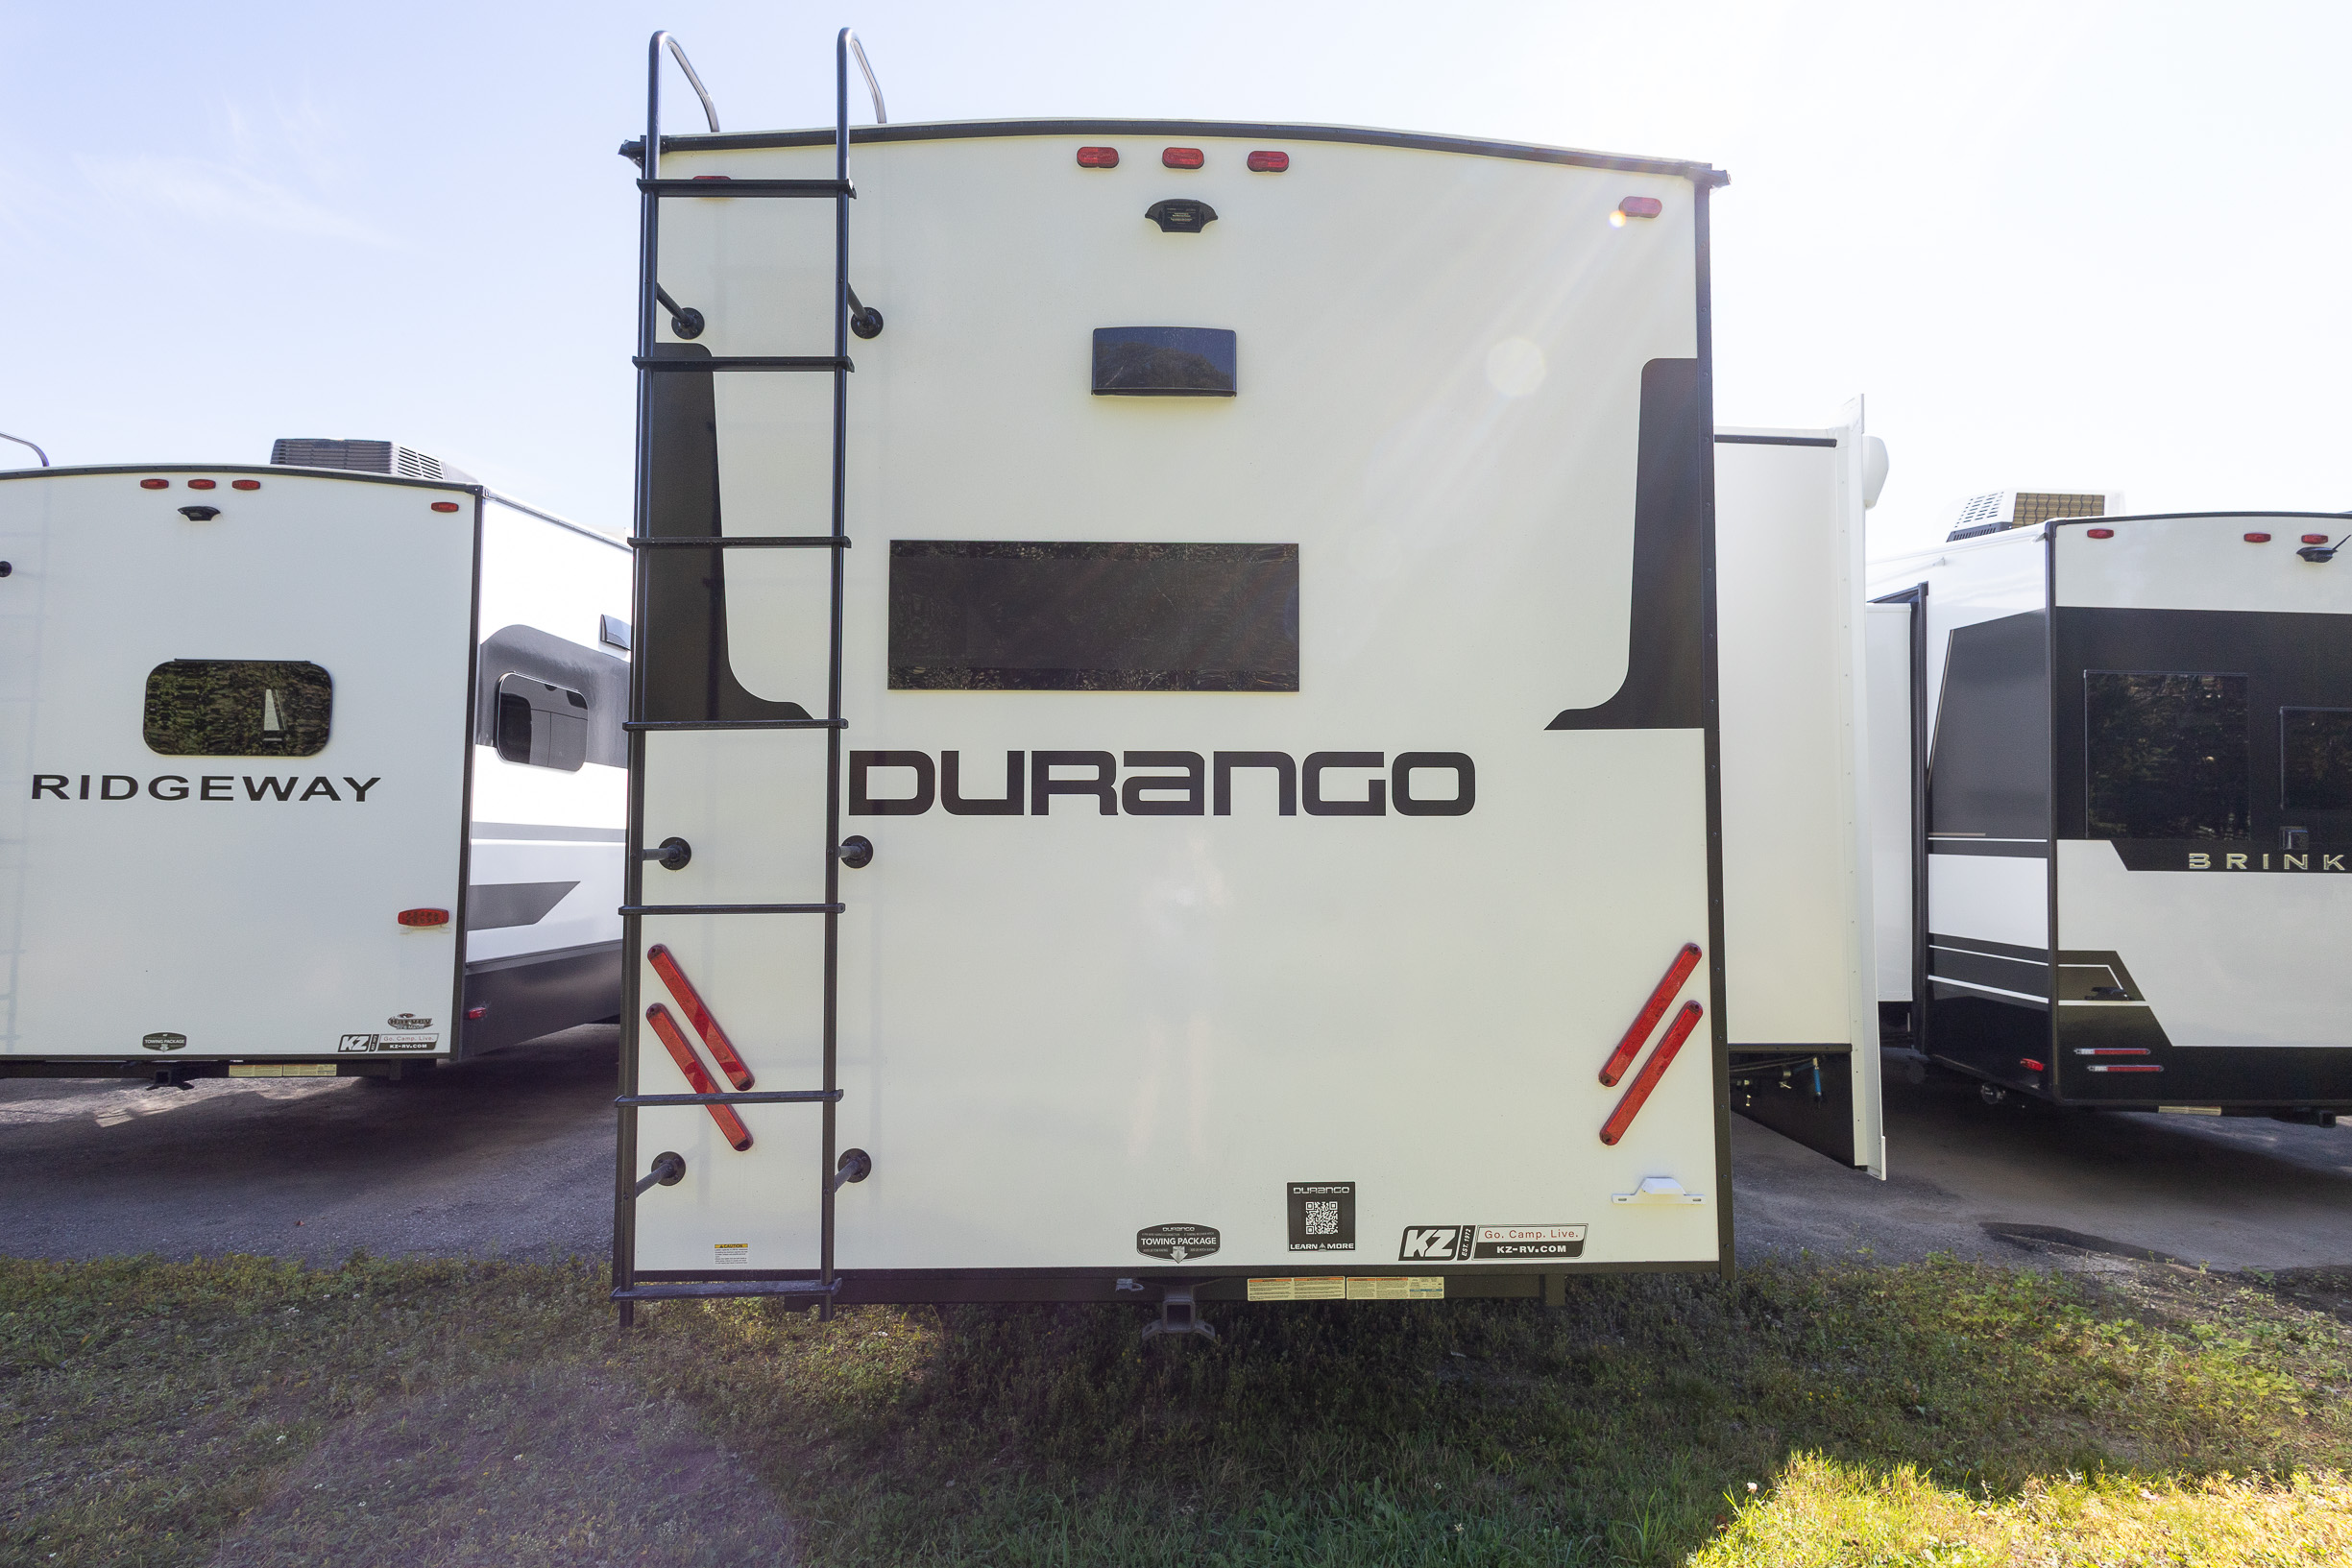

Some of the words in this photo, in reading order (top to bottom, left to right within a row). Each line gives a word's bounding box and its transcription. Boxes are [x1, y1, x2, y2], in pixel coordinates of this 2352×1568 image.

[31, 774, 381, 803] RIDGEWAY
[849, 750, 1476, 816] DURANGO
[2189, 853, 2345, 871] BRINK
[340, 1035, 369, 1051] KZ
[1293, 1186, 1350, 1194] DURANGO
[1177, 1237, 1217, 1245] PACKAGE
[1484, 1230, 1505, 1239] Go.
[1509, 1230, 1546, 1240] Camp.
[1550, 1228, 1579, 1238] Live.
[1403, 1229, 1457, 1258] KZ
[1461, 1243, 1469, 1257] EST.
[1496, 1244, 1567, 1254] KZ-RV.COM
